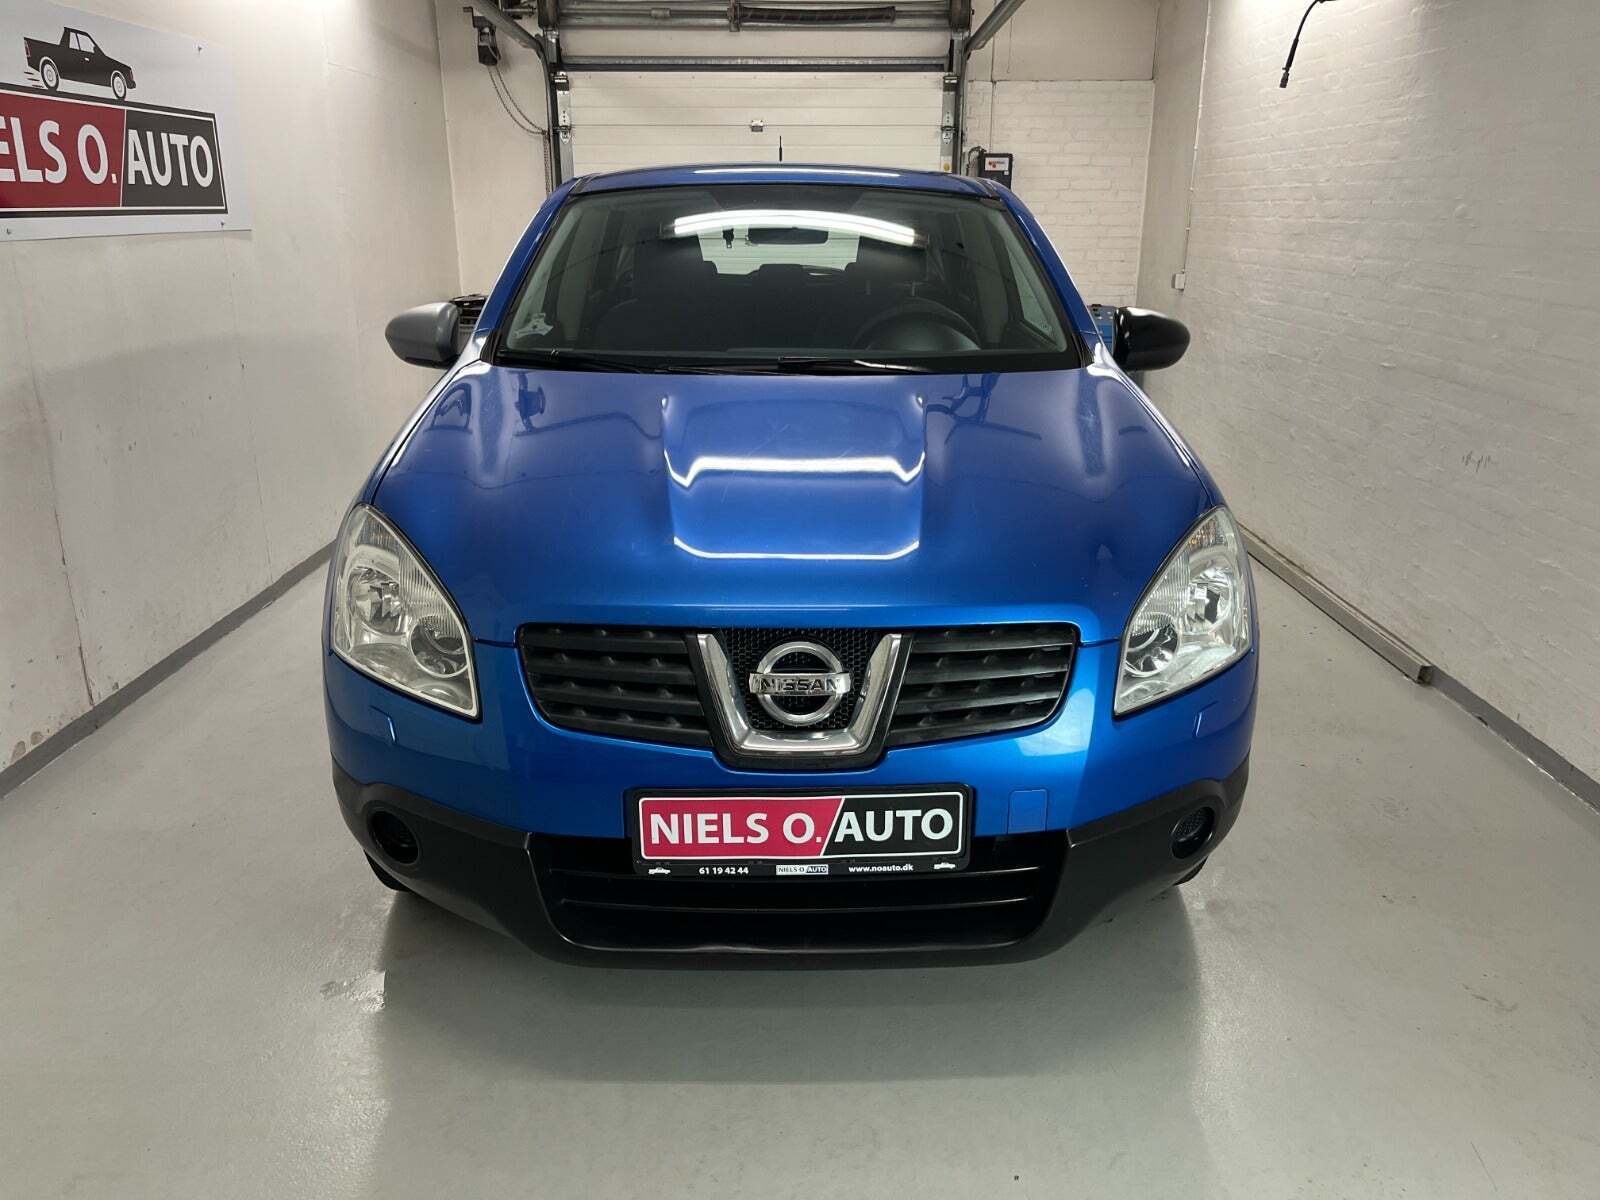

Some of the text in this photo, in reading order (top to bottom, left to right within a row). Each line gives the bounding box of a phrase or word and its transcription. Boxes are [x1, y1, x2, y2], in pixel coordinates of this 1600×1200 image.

[77, 123, 118, 185] O.
[127, 129, 214, 188] AUTO
[760, 678, 838, 691] NISSAN
[650, 808, 954, 845] NIELS O. AUTO
[698, 866, 749, 875] 61 19 42 44
[808, 865, 827, 873] AUTO
[848, 864, 914, 872] www.noauto.dk
